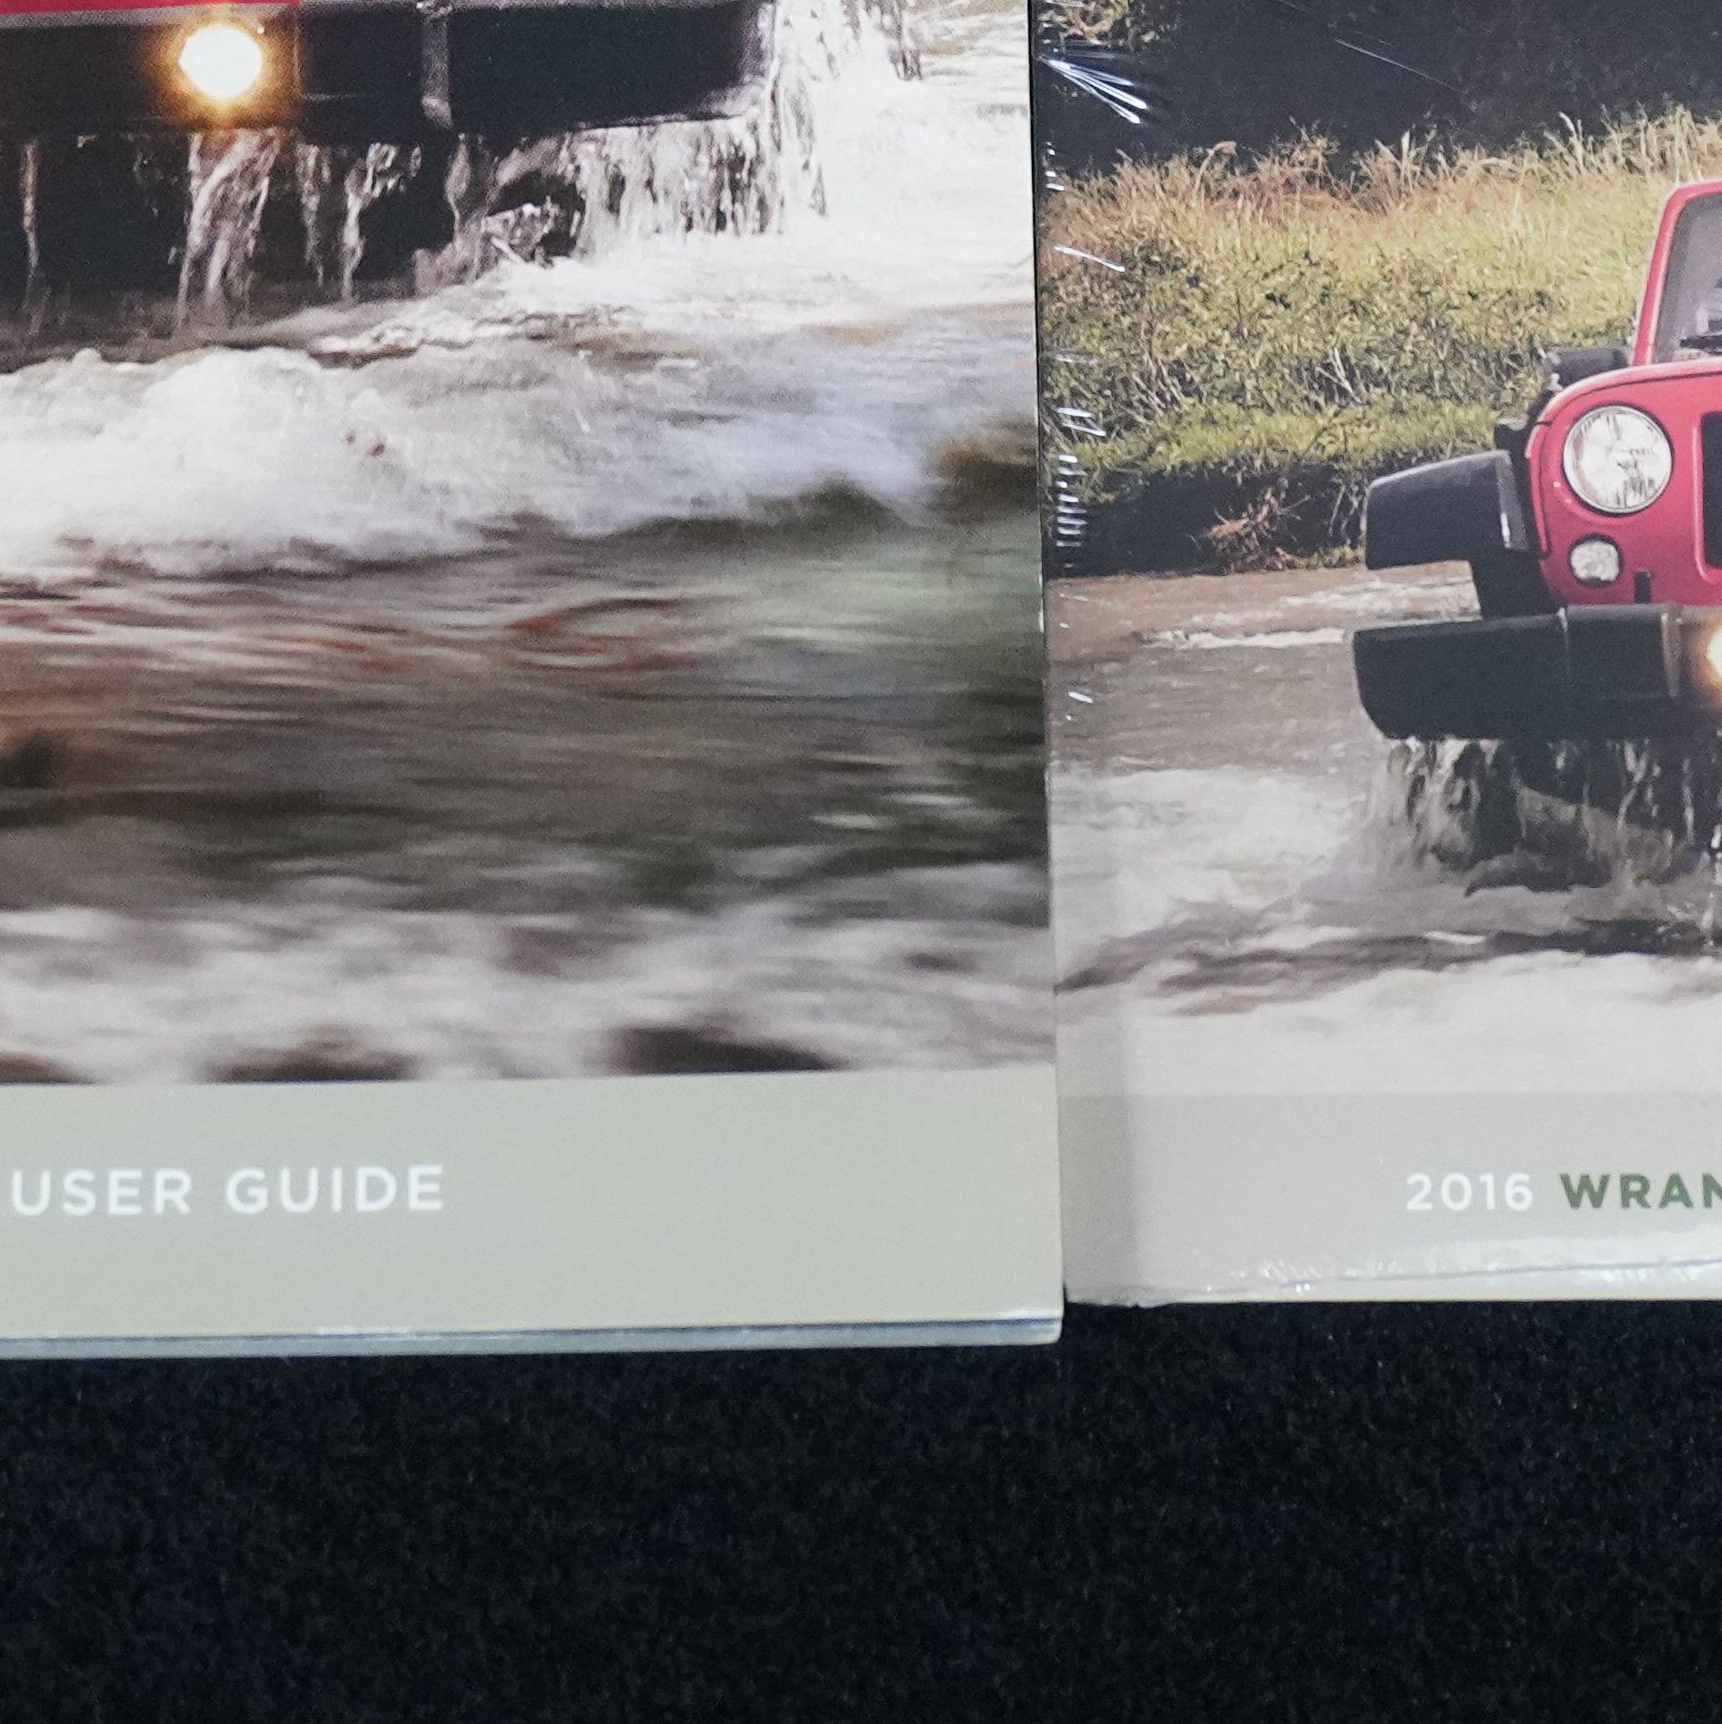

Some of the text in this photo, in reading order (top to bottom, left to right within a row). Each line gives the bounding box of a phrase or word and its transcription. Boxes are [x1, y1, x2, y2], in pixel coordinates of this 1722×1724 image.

[11, 1168, 191, 1215] USER
[226, 1164, 443, 1213] GUIDE
[1406, 1172, 1533, 1211] 2016
